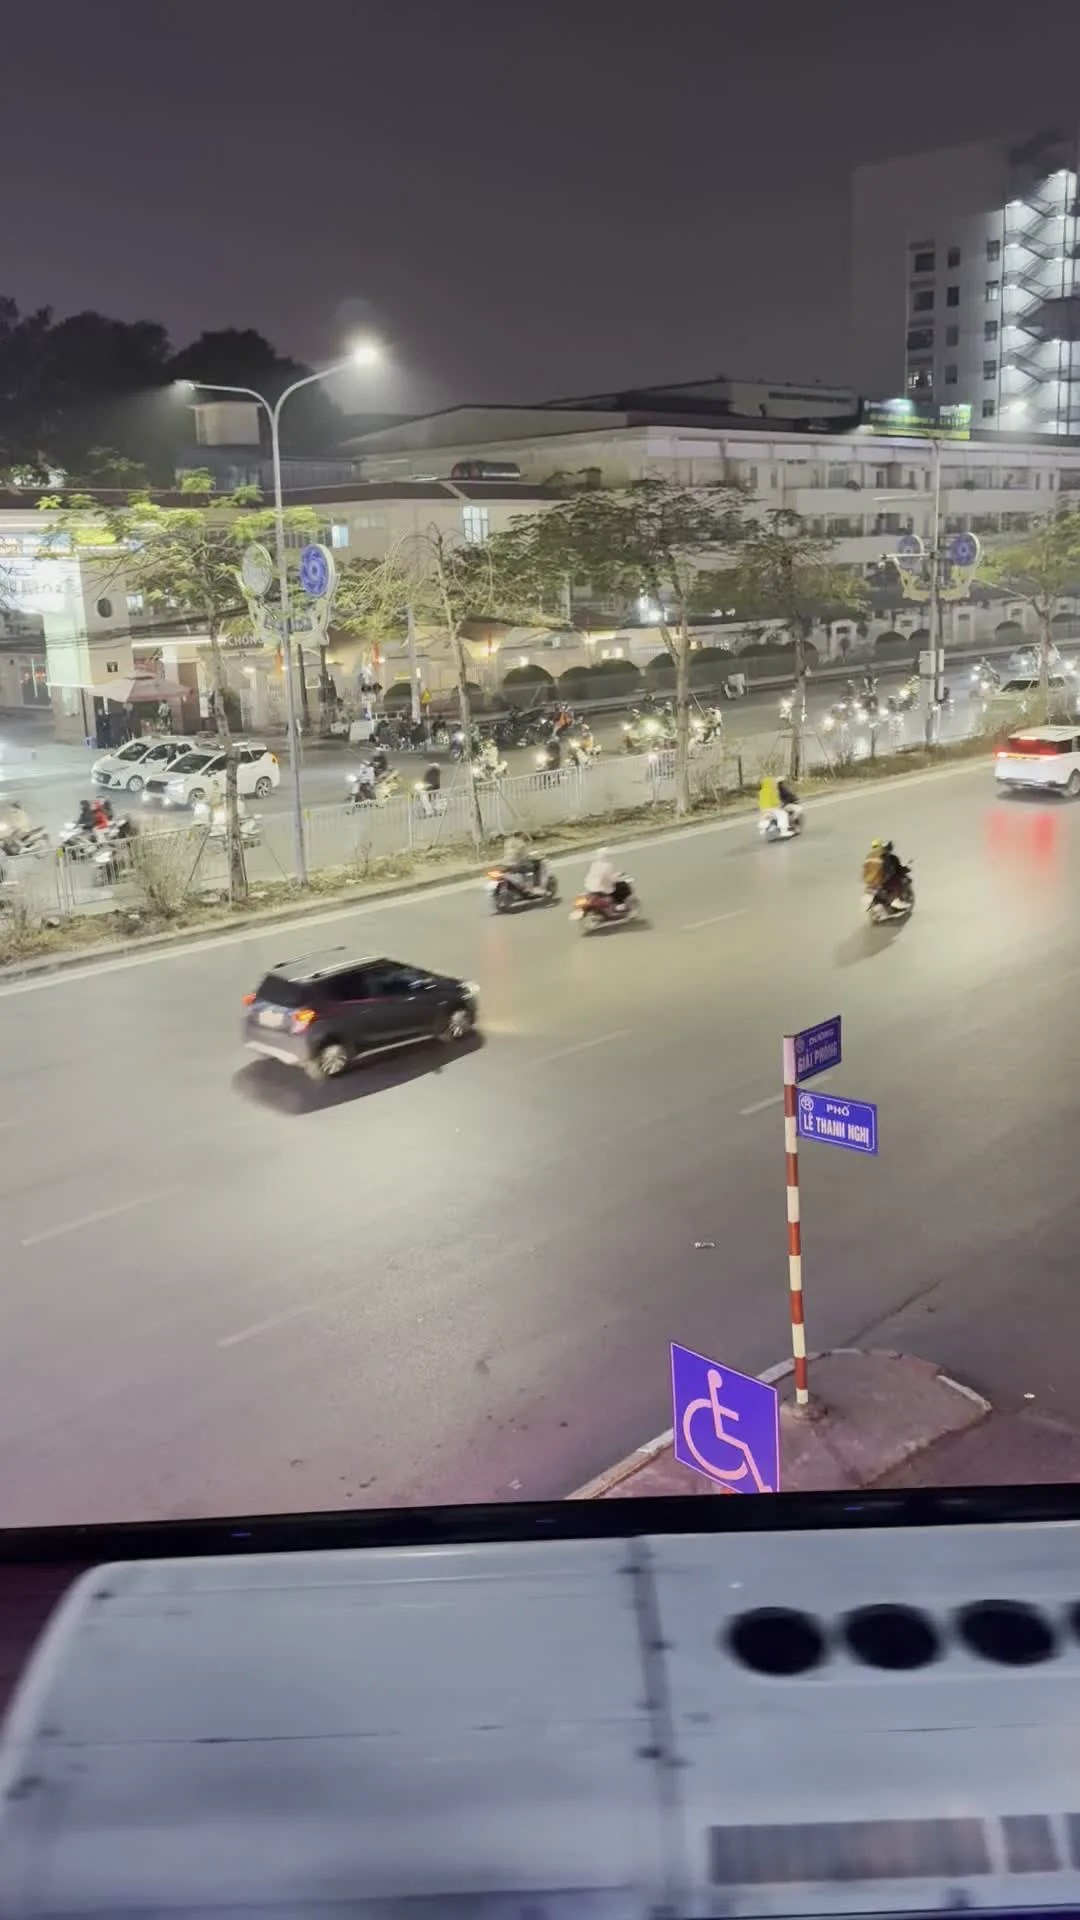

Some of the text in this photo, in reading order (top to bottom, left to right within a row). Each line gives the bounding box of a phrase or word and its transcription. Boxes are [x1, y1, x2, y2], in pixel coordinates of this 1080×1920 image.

[826, 1104, 850, 1117] PHỐ
[803, 1111, 869, 1148] LÊ THANH NGHỊ
